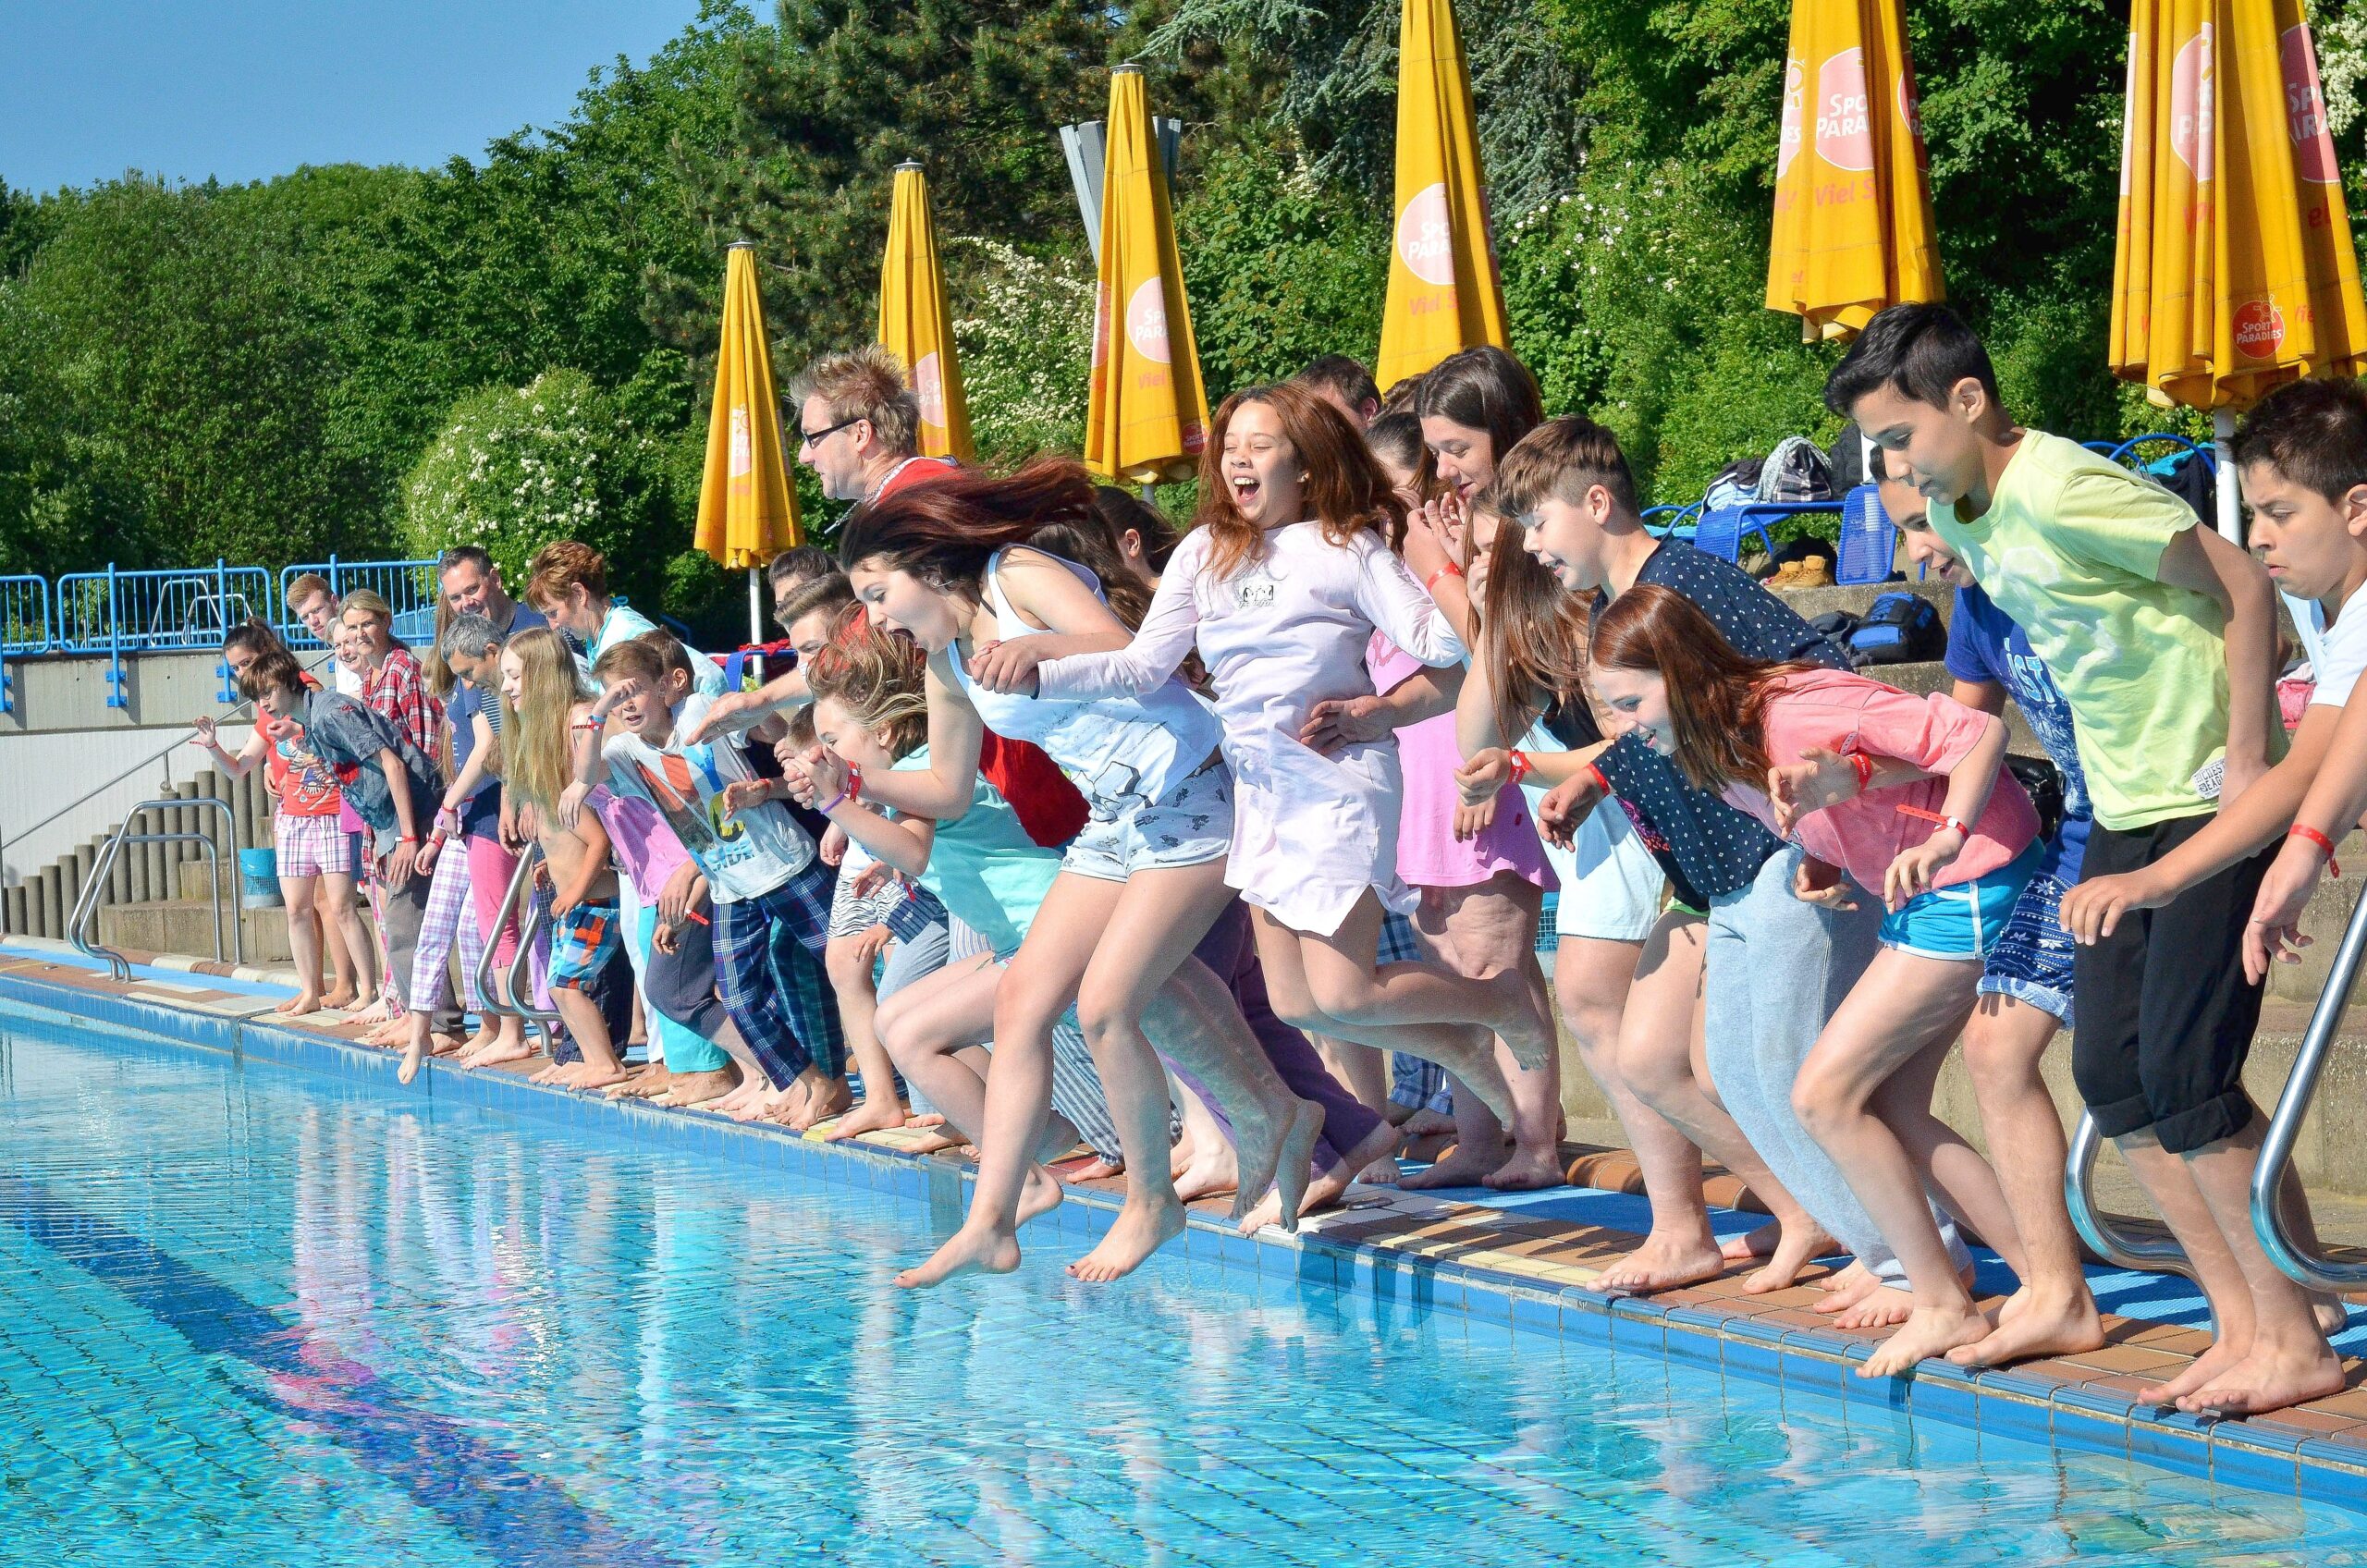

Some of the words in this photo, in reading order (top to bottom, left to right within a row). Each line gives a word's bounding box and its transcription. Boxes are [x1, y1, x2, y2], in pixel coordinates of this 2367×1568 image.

[1816, 181, 1856, 207] Viel
[2241, 322, 2272, 334] SPORT
[2236, 329, 2283, 345] PARADIES
